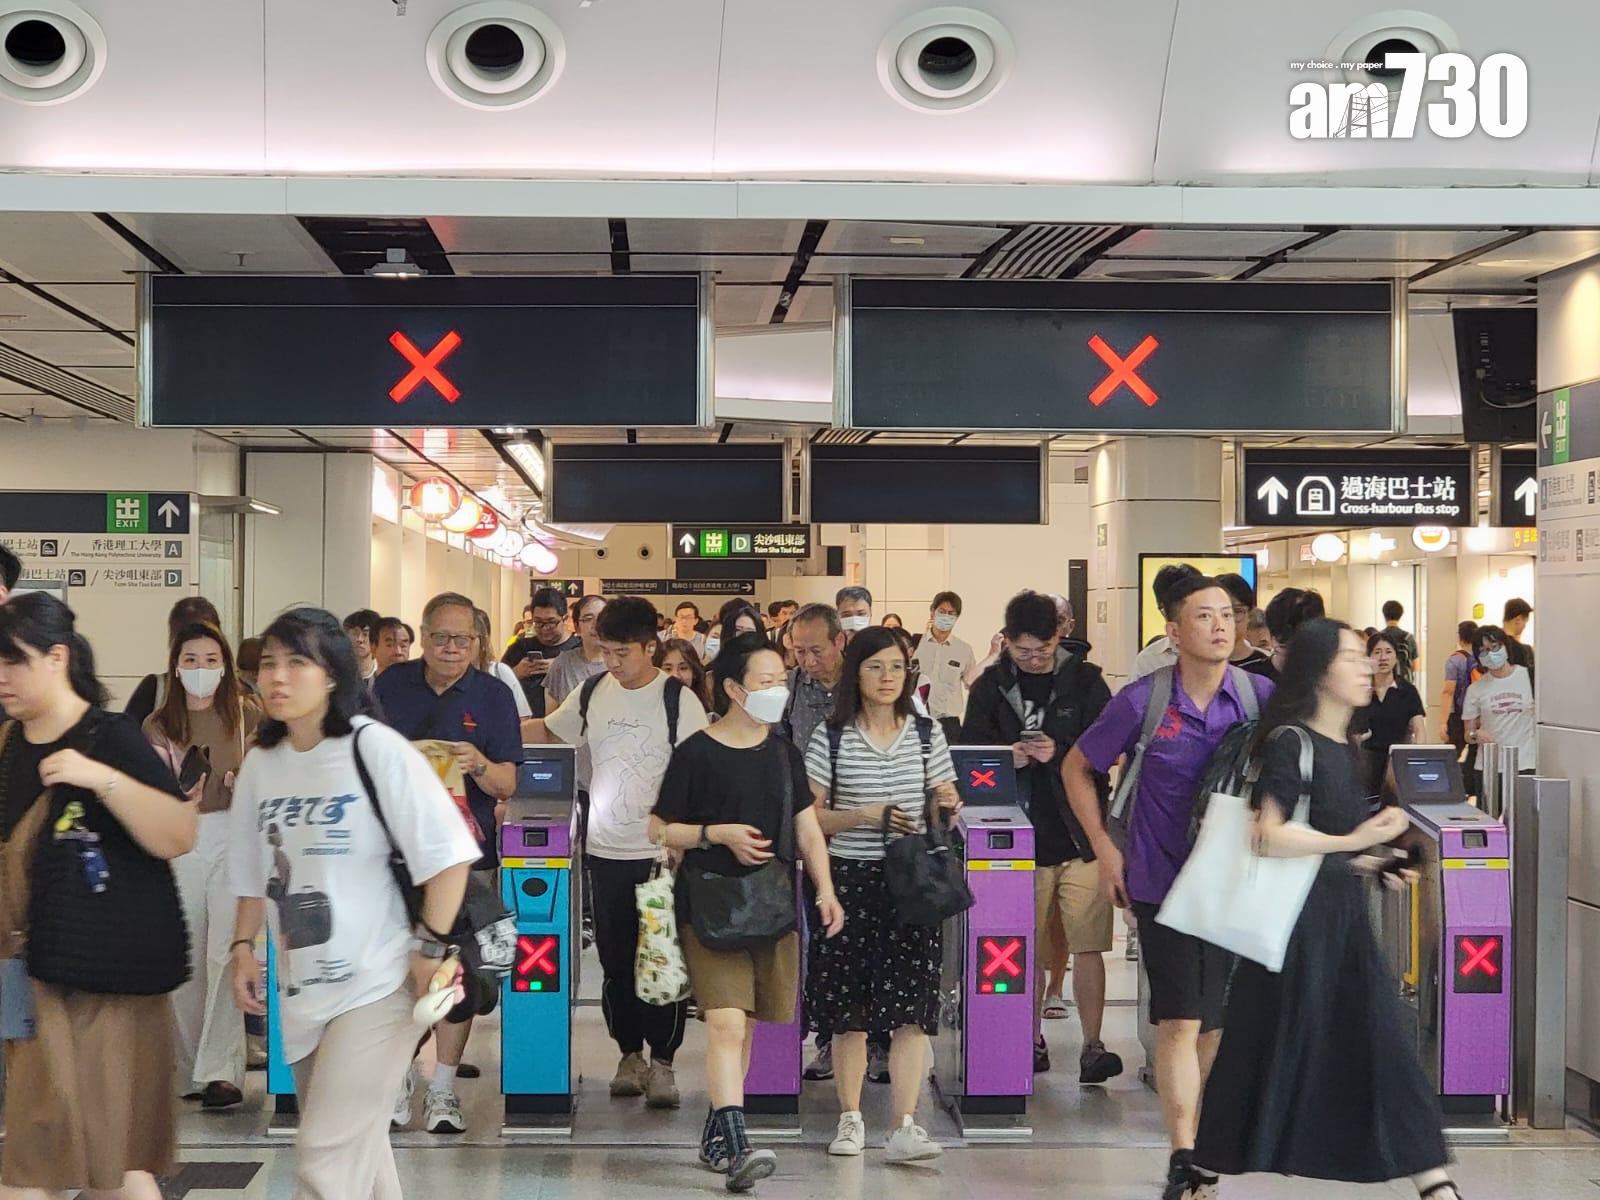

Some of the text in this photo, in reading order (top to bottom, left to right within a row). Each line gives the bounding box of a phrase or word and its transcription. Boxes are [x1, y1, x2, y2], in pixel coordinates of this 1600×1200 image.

[1340, 475, 1456, 500] 過海巴士站
[1340, 502, 1460, 516] Cross-harbour Bus stop
[115, 520, 140, 528] EXIT
[92, 539, 162, 551] 香港理工大學
[735, 537, 747, 550] D
[754, 533, 805, 546] 尖沙咀東部
[168, 543, 179, 556] A
[103, 569, 162, 580] 尖沙咀東部
[168, 573, 178, 584] D
